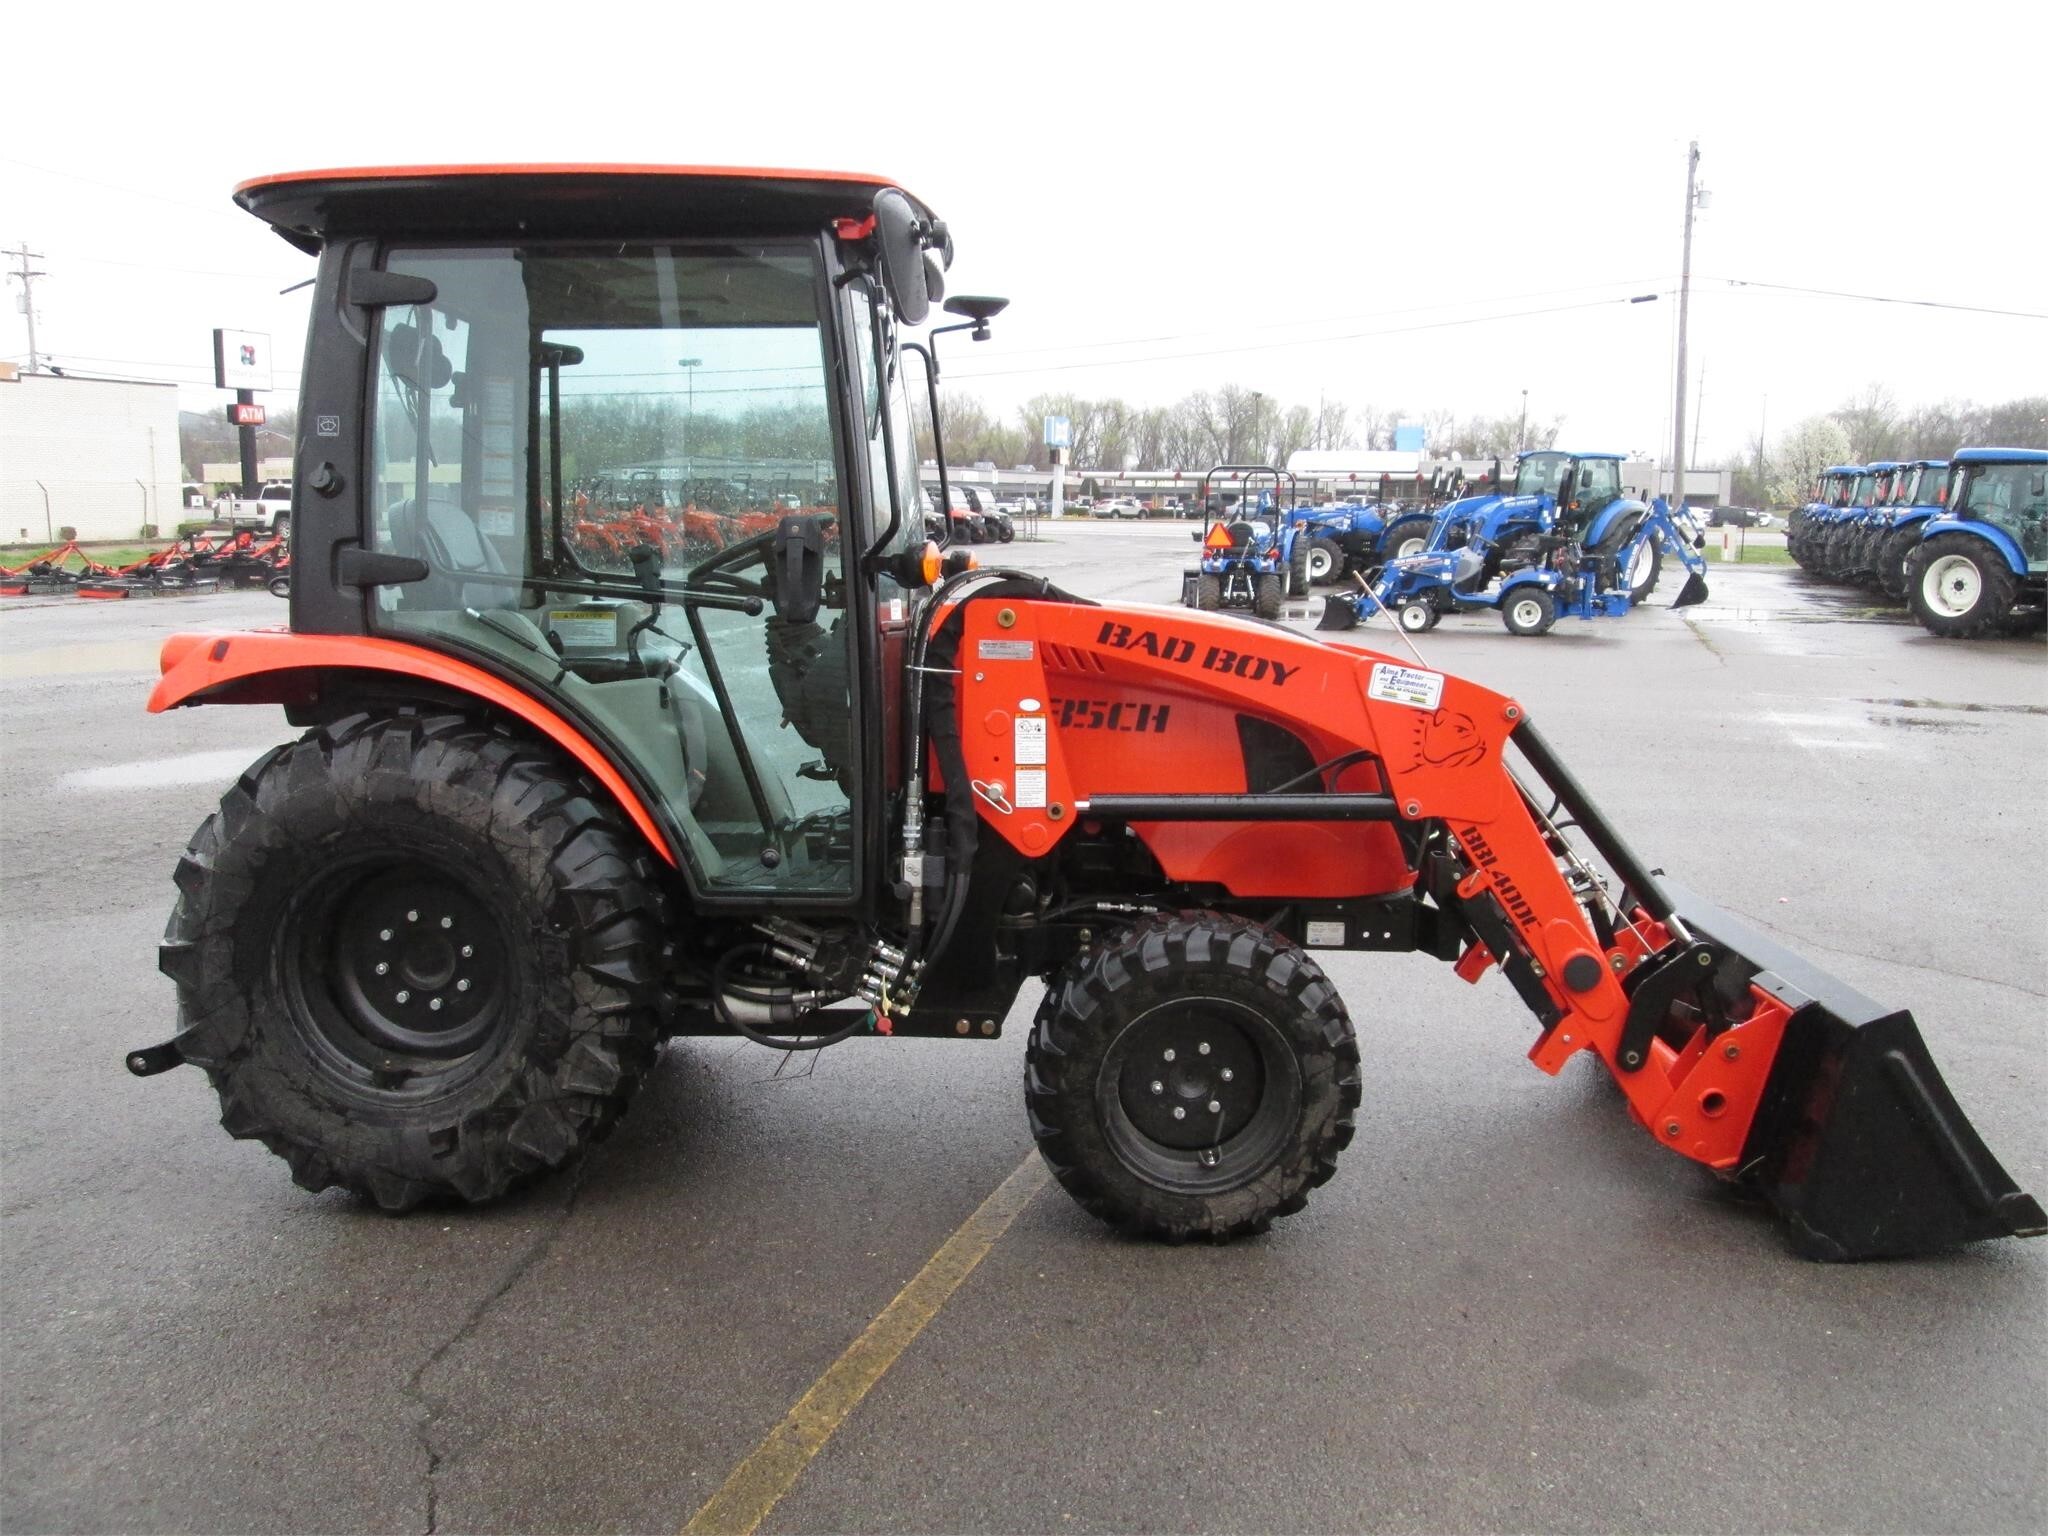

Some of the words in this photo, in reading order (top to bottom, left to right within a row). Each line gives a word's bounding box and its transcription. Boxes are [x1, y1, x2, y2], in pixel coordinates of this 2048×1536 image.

[240, 408, 263, 421] ATM
[1096, 621, 1196, 664] BAD
[1201, 646, 1301, 687] BOY
